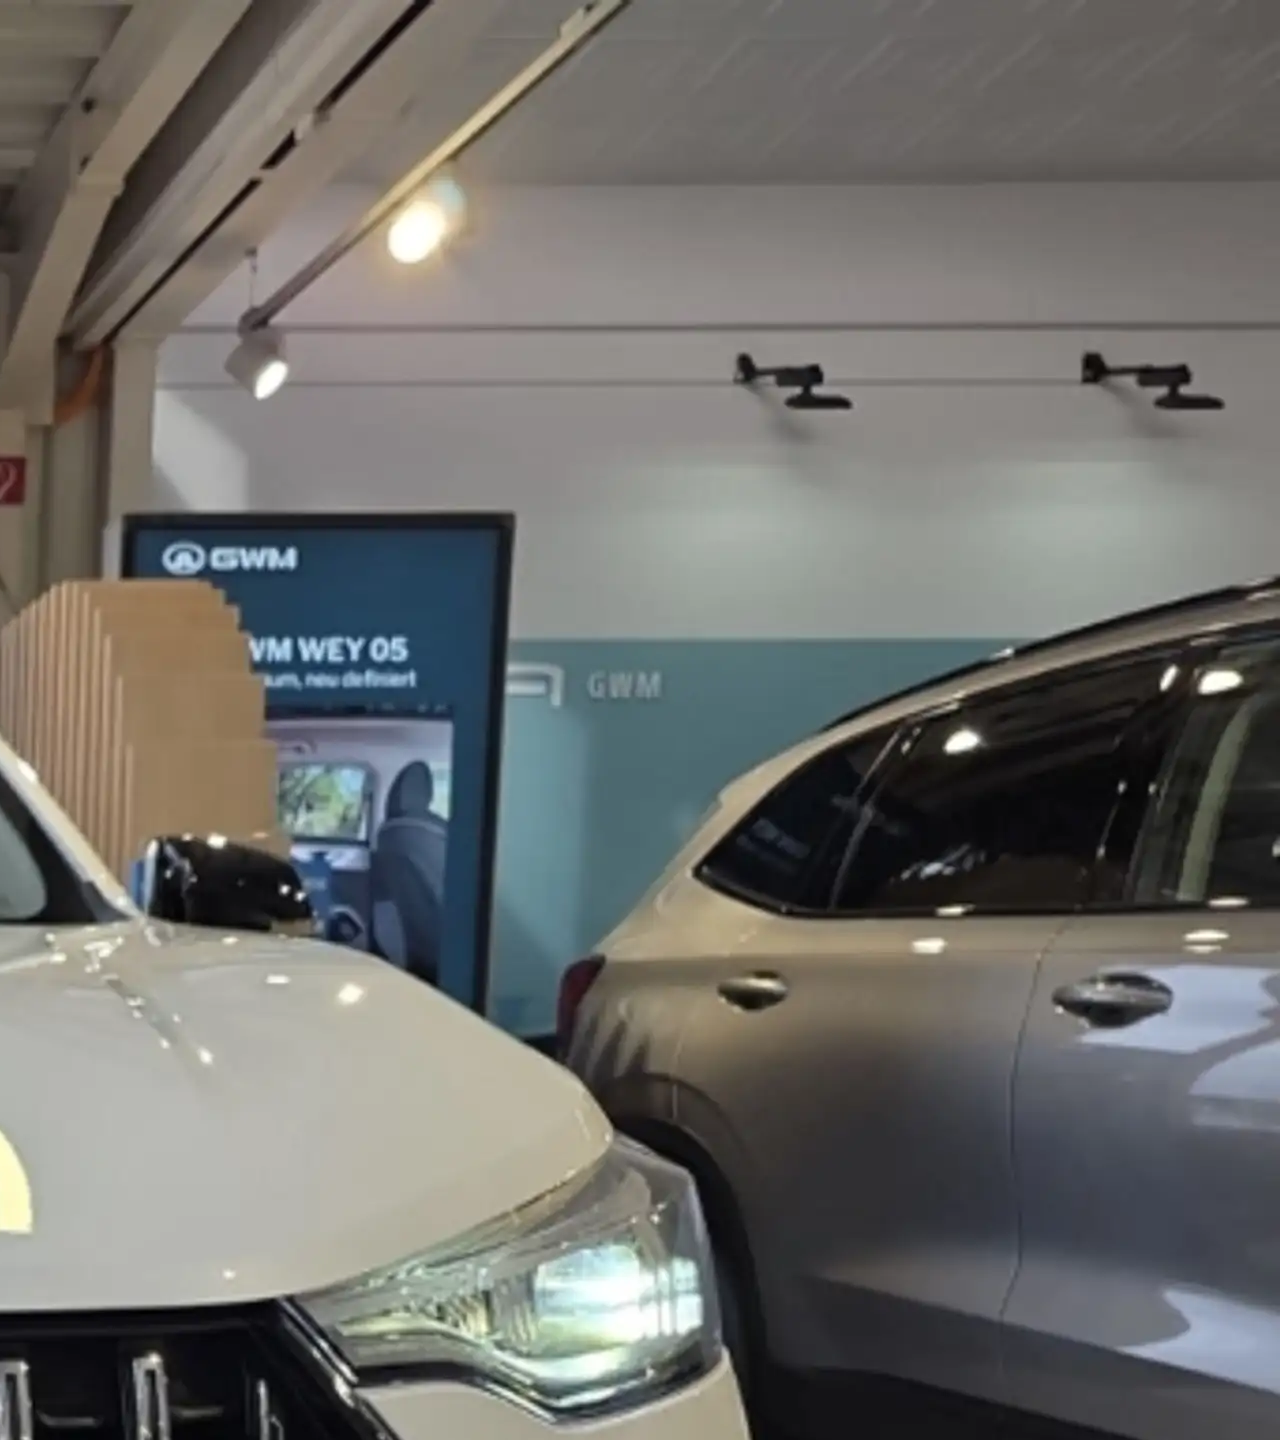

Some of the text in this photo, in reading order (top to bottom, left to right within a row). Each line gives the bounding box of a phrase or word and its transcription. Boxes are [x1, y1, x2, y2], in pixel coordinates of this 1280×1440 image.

[210, 546, 298, 571] GWM
[249, 636, 409, 663] WM WEY 05
[342, 668, 417, 688] definiert
[586, 670, 662, 699] GWM
